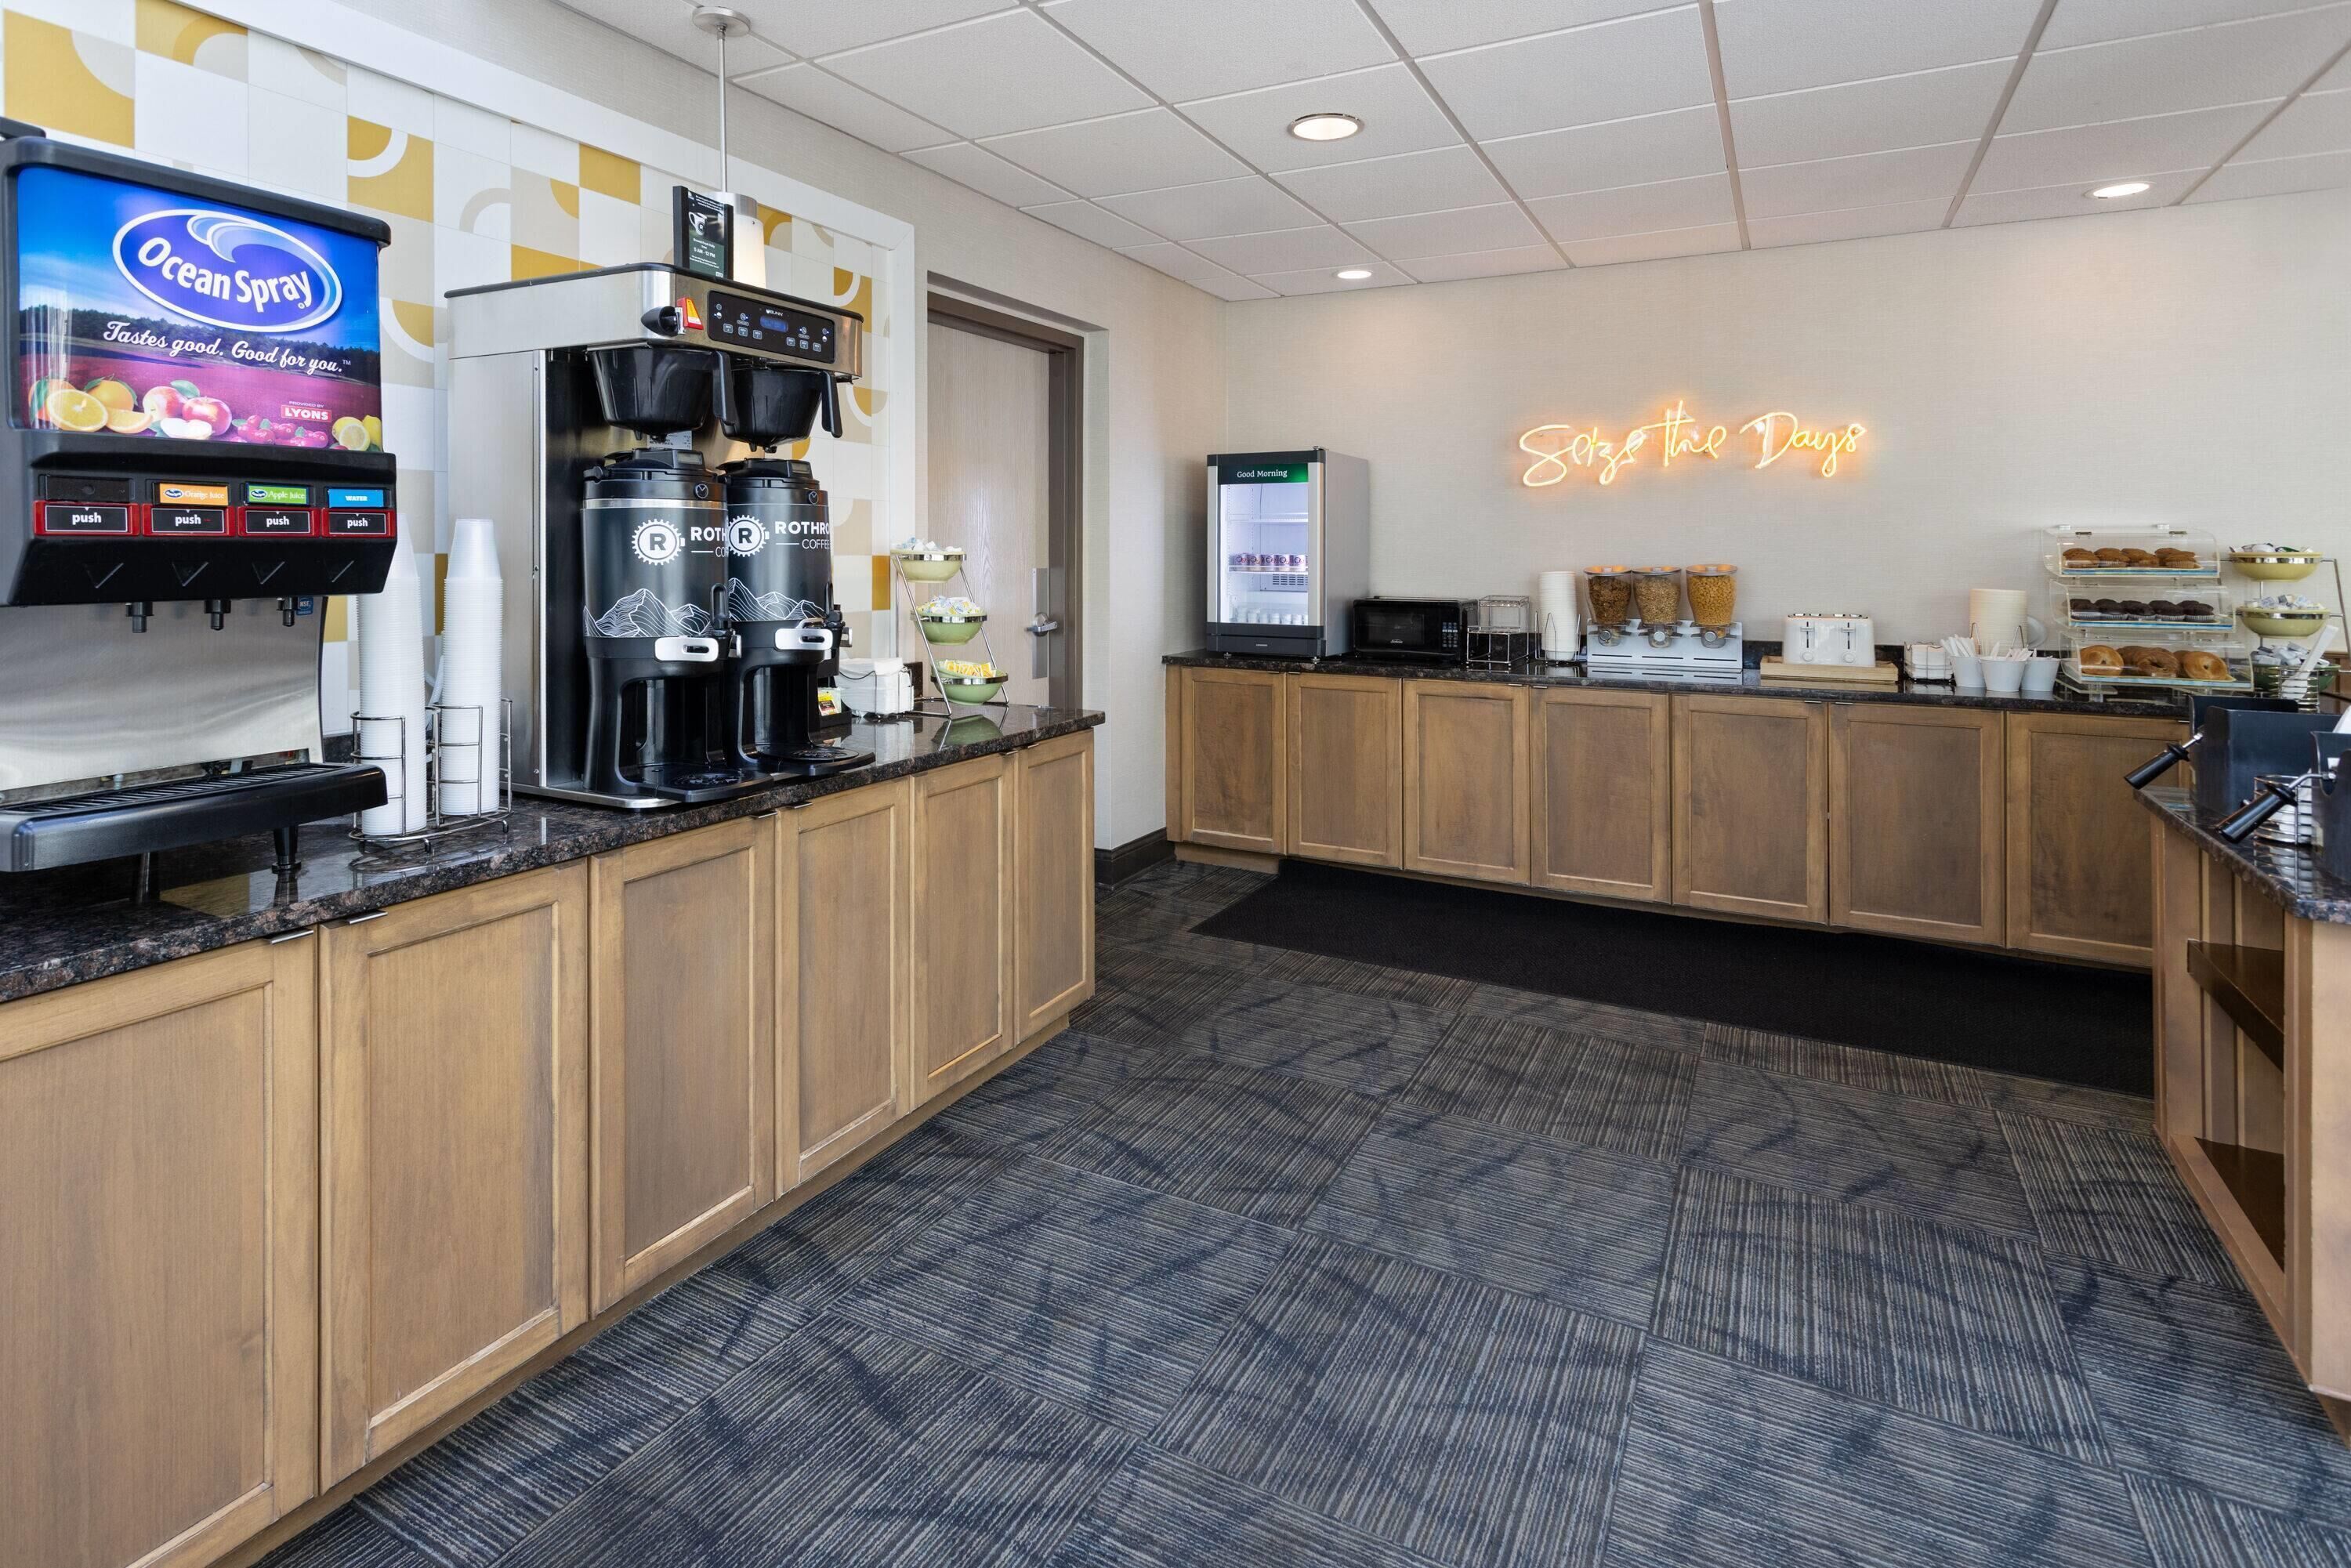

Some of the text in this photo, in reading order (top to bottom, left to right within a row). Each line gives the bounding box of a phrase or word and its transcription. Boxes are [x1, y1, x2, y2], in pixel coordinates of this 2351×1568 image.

[138, 237, 313, 313] Ocean Spray
[103, 320, 168, 348] Tastes
[172, 338, 224, 357] good.
[231, 340, 278, 363] Good
[278, 348, 306, 368] for
[284, 407, 329, 421] LYONS
[1519, 400, 1867, 486] Seize the Days
[1256, 469, 1288, 478] Morning
[184, 490, 208, 500] Orange
[268, 491, 288, 500] Apple
[71, 512, 102, 526] push
[175, 514, 201, 527] push
[266, 516, 290, 527] push
[346, 517, 368, 529] push
[649, 533, 667, 551] R
[738, 527, 753, 544] R
